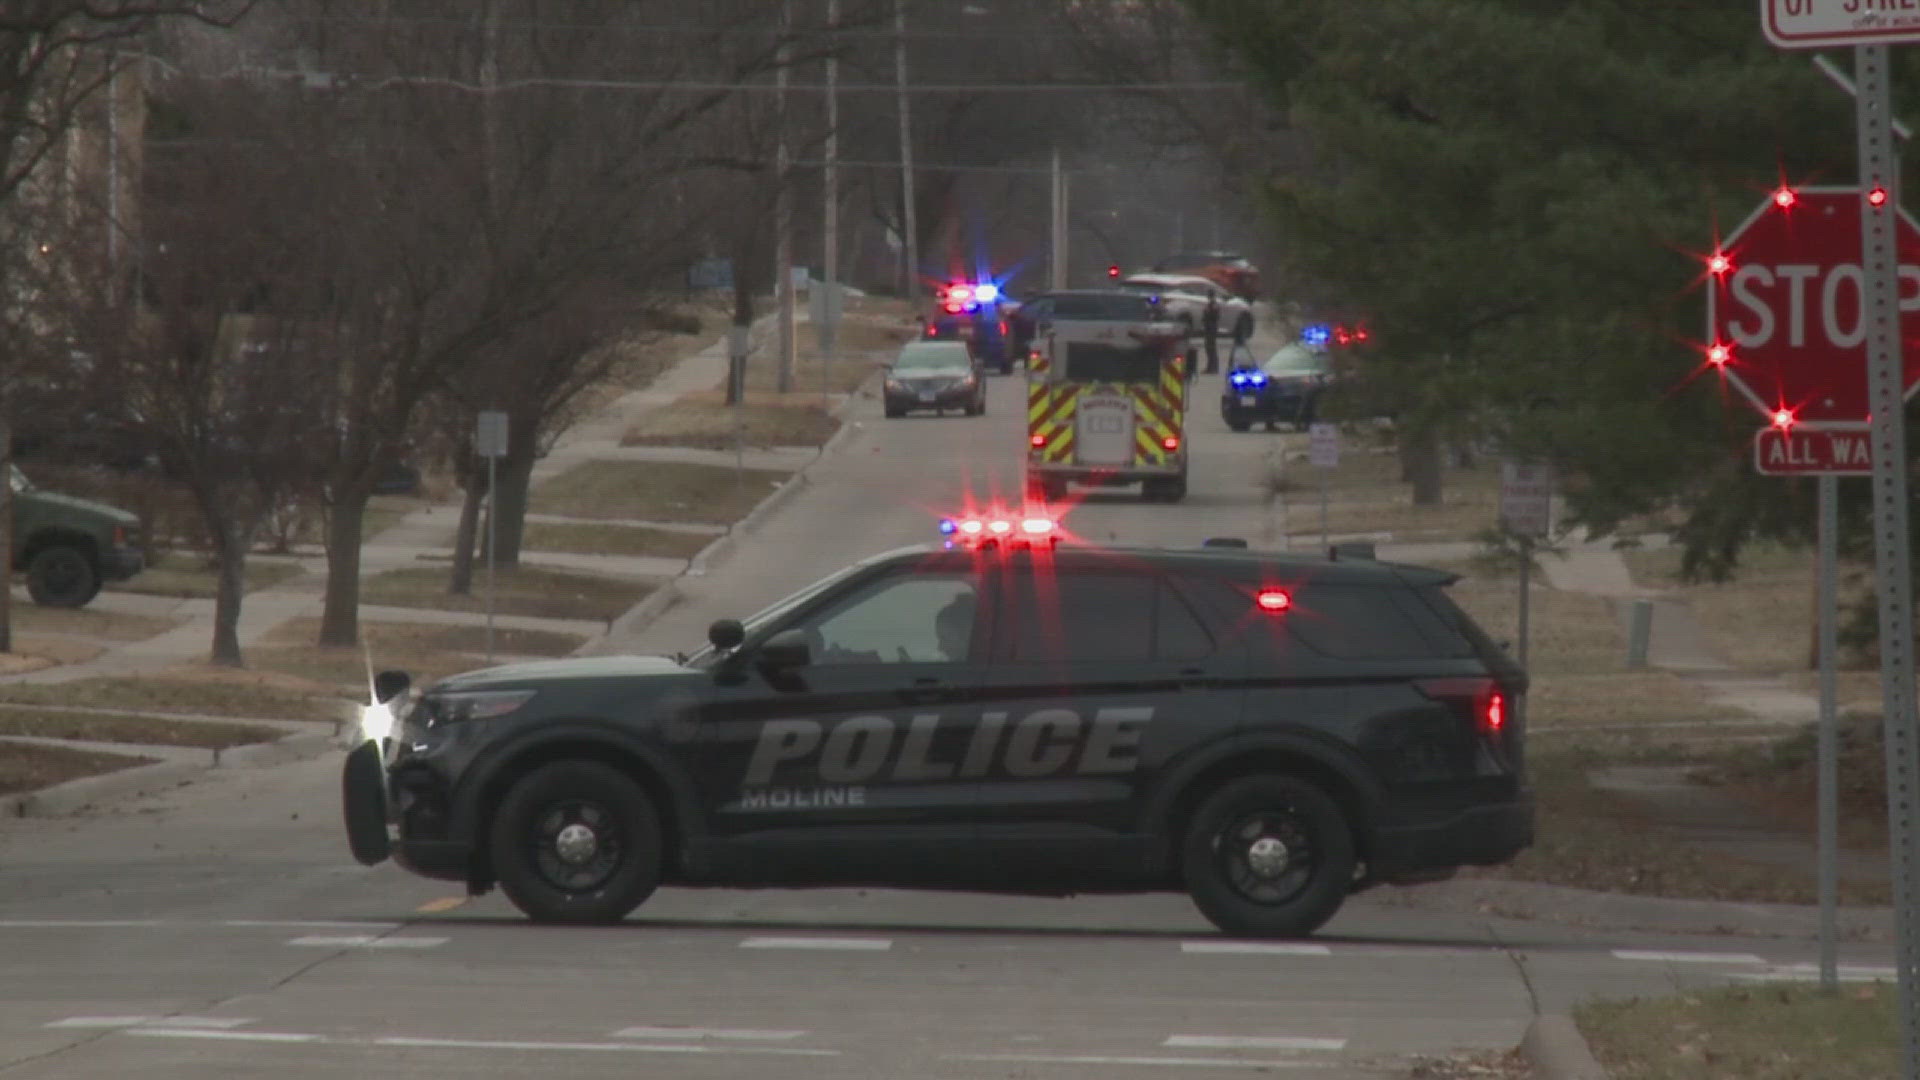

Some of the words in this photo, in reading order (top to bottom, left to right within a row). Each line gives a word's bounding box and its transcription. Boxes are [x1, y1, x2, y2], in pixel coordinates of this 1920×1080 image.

[1768, 437, 1818, 465] ALL
[1831, 437, 1870, 465] WA
[742, 706, 1155, 785] POLICE
[741, 785, 866, 809] MOLINE
